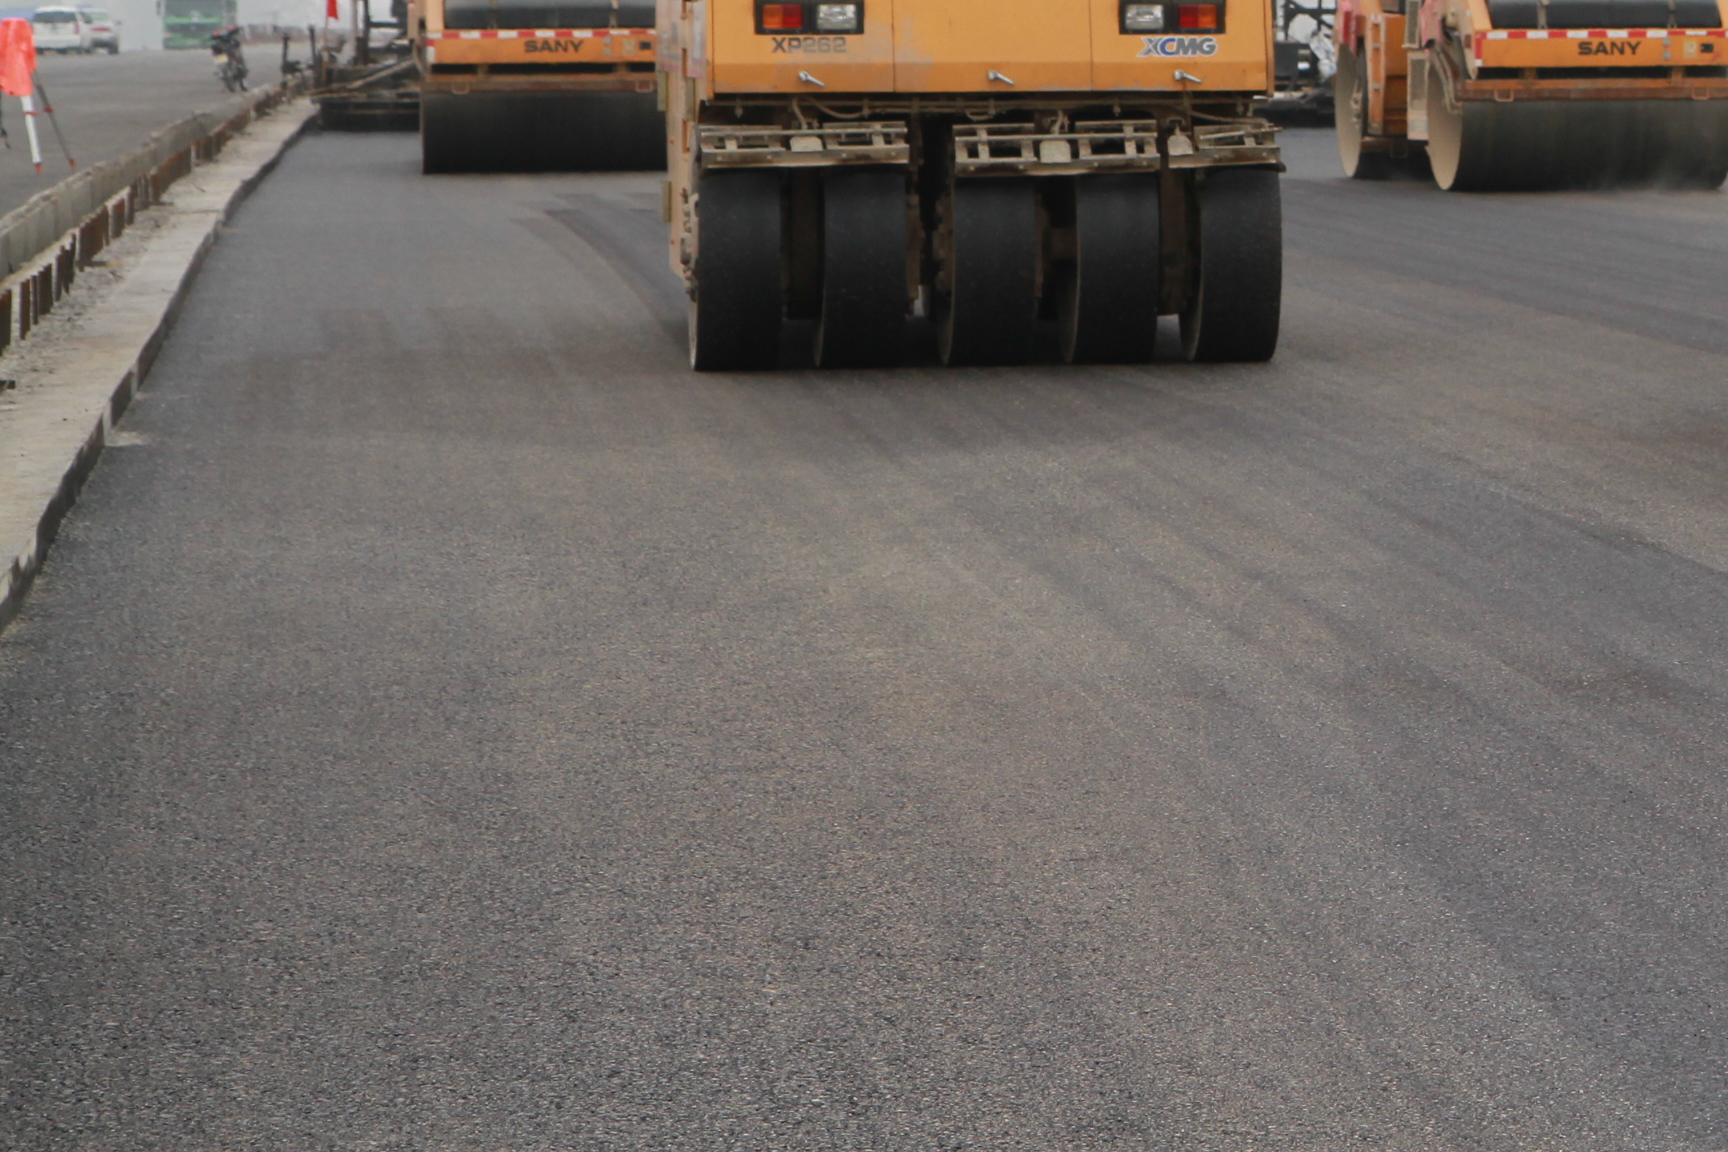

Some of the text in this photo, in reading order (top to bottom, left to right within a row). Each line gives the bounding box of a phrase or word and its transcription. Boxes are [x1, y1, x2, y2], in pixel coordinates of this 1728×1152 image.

[524, 39, 584, 54] SANY
[771, 36, 848, 54] XP262
[1136, 35, 1219, 58] XCMG
[1577, 40, 1642, 56] SANY
